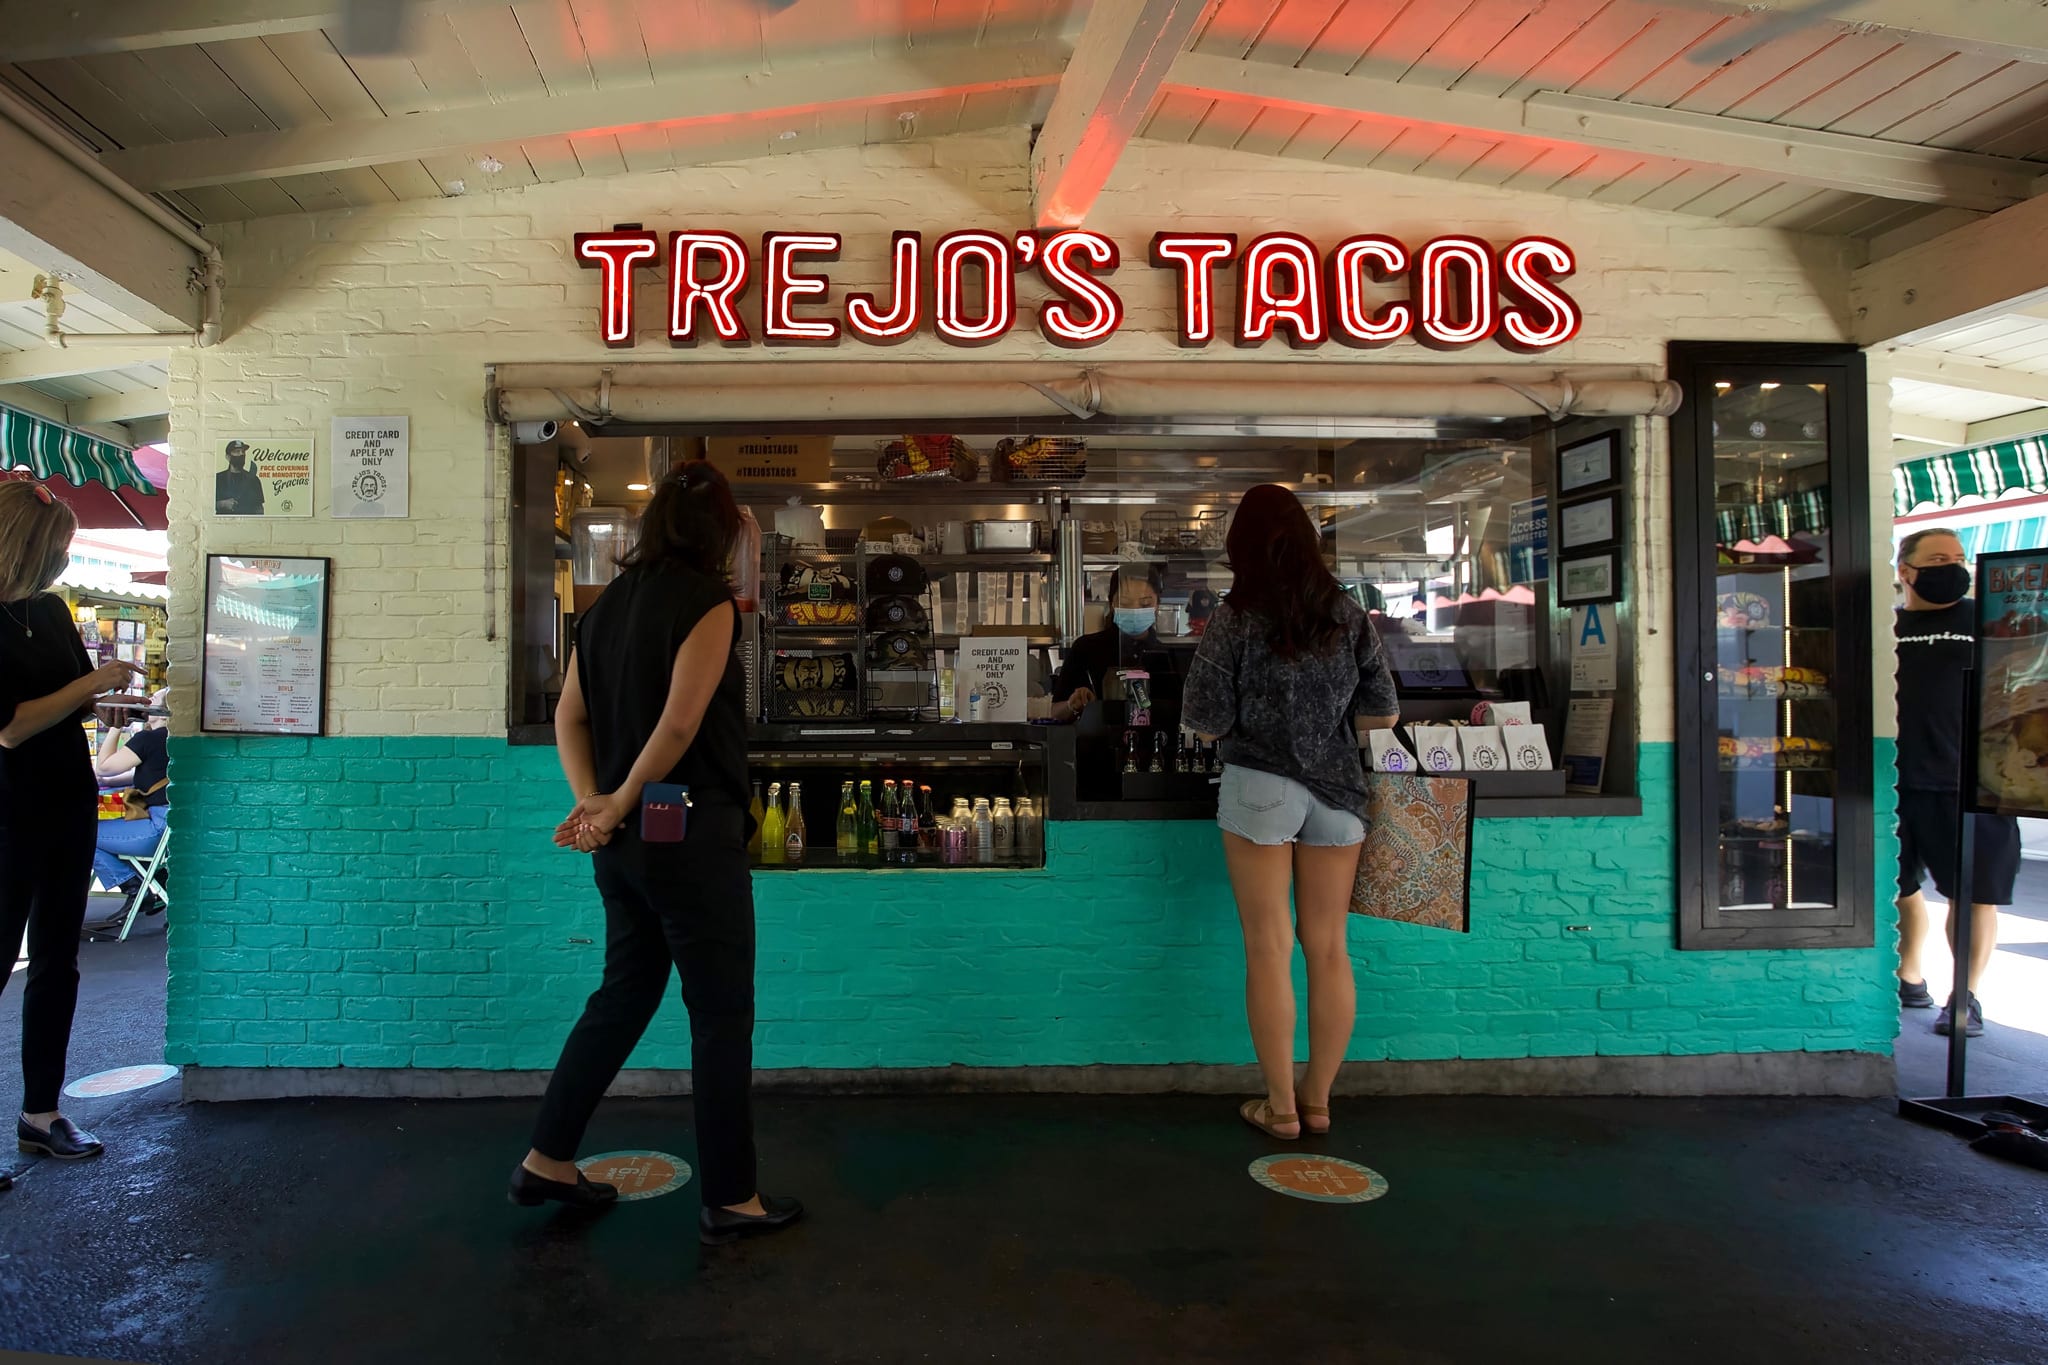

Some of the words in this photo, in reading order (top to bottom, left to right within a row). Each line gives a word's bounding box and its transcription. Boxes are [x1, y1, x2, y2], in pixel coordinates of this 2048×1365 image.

[574, 228, 1123, 348] TREJO'S
[1149, 231, 1582, 354] TACOS
[345, 430, 375, 439] CREDIT
[377, 430, 400, 439] CARD
[364, 440, 381, 448] AND
[252, 448, 310, 462] Welcome
[350, 448, 377, 457] APPLE
[380, 448, 394, 456] PAY
[362, 457, 382, 466] ONLY
[272, 478, 310, 496] Gracias
[373, 470, 386, 488] TACOS
[1511, 517, 1547, 535] ACCESS
[1580, 604, 1606, 646] A
